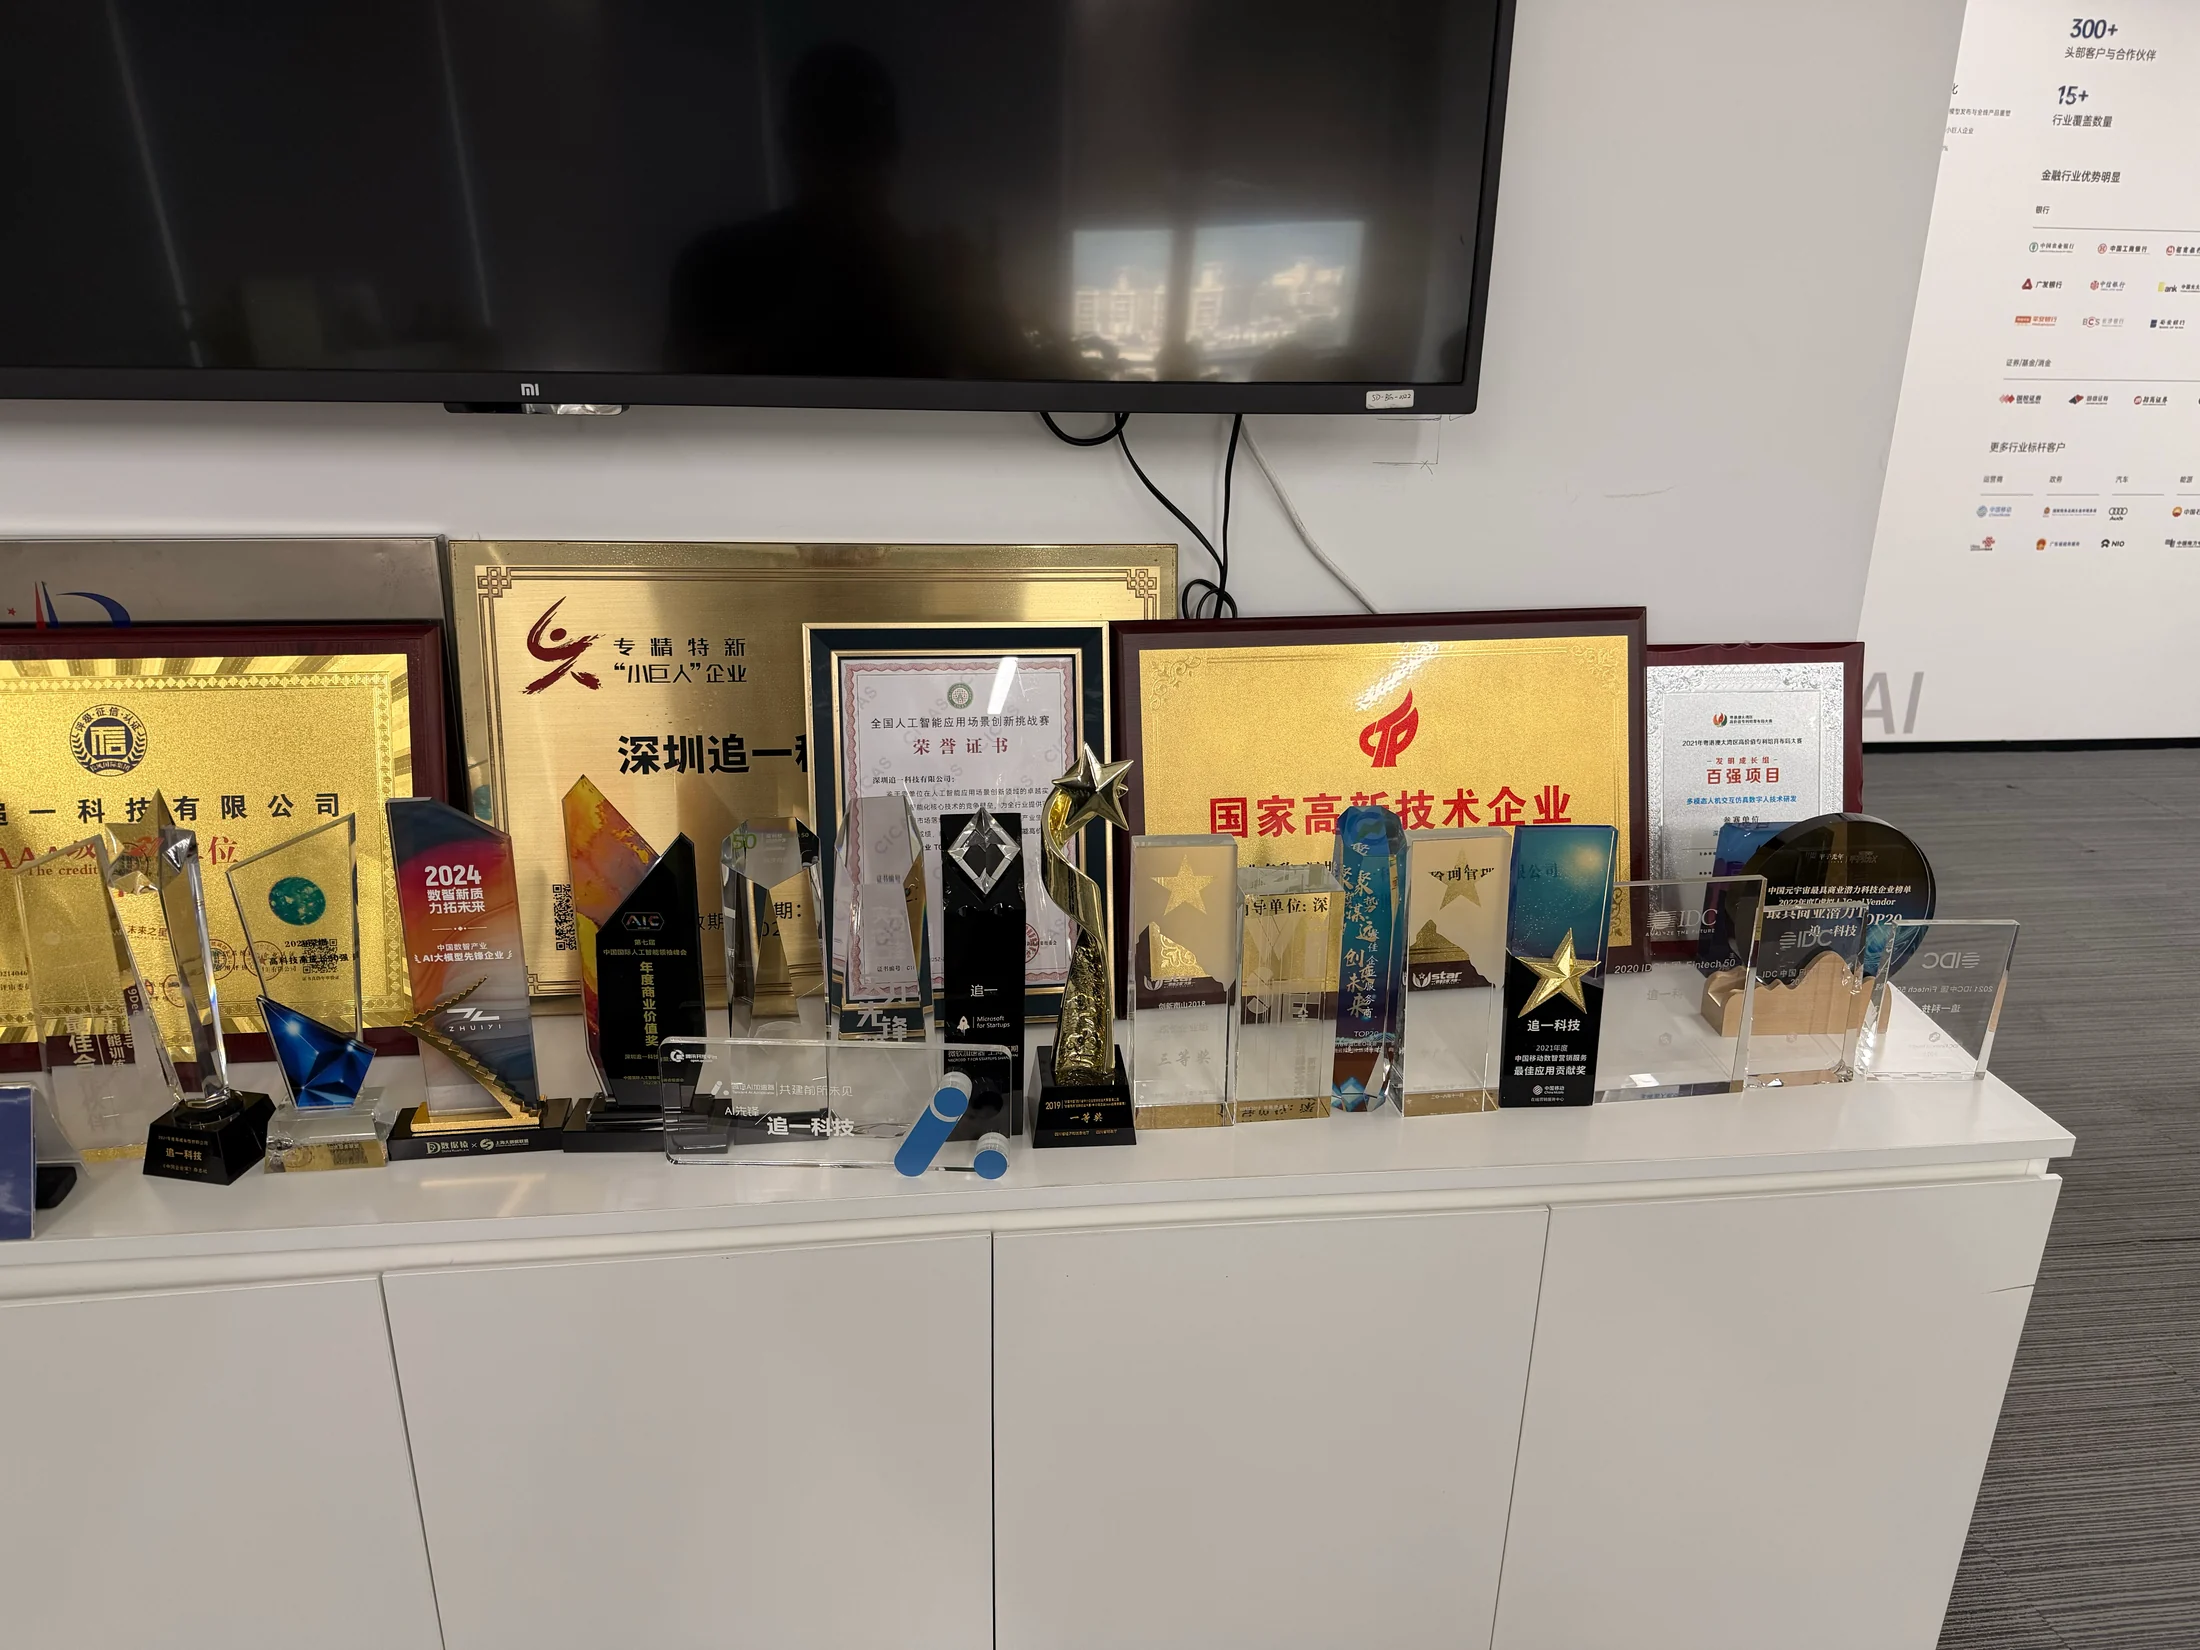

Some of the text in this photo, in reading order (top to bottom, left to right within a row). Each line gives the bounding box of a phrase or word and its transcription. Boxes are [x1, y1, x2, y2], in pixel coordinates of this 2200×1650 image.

[2070, 18, 2118, 39] 300+
[2064, 46, 2157, 62] 头部客户与合作伙伴
[2057, 85, 2089, 105] 15+
[2052, 114, 2113, 128] 行业覆盖数量
[2041, 169, 2121, 183] 金融行业优势明显
[2035, 205, 2050, 215] 银行
[1989, 442, 2066, 453] 更多行业标杆客户
[2115, 475, 2129, 484] 汽车
[2111, 540, 2125, 548] NIO
[613, 638, 746, 657] 专精特新
[871, 715, 1050, 729] 全国人工智能应用场景创新挑战赛
[913, 737, 1008, 755] 荣誉证书
[1707, 767, 1780, 785] 百强项目
[59, 866, 98, 875] credit
[424, 864, 482, 887] 2024
[426, 888, 484, 902] 数智新质
[1768, 885, 1912, 895] 中国元宇宙最具商业潜力科技企业榜单
[429, 901, 486, 914] 力拓未来
[626, 915, 660, 926] AIC
[1678, 908, 1718, 927] IDC
[1809, 925, 1858, 937] 追一科技
[1797, 930, 1832, 948] IDC
[437, 942, 488, 951] 中国数智产业
[603, 948, 687, 956] 中国国际人工智能领袖峰会
[423, 950, 504, 963] AI大模型先锋企业
[1614, 965, 1639, 974] 2020
[1724, 958, 1736, 967] 50
[970, 984, 998, 997] 追一
[639, 961, 659, 1047] 年度商业价值奖
[1527, 1019, 1580, 1032] 追一科技
[1536, 1044, 1568, 1052] 2021年度
[1157, 1050, 1212, 1067] 三等奖
[1515, 1054, 1587, 1062] 中国移动数智营销服务
[1514, 1066, 1586, 1076] 最佳应用贡献奖
[780, 1084, 853, 1097] 共建前所未见
[724, 1106, 760, 1116] AI先锋
[1045, 1101, 1061, 1110] 2019
[1069, 1112, 1103, 1123] 一等奖
[767, 1117, 855, 1137] 追一科技
[166, 1148, 202, 1161] 追一科技
